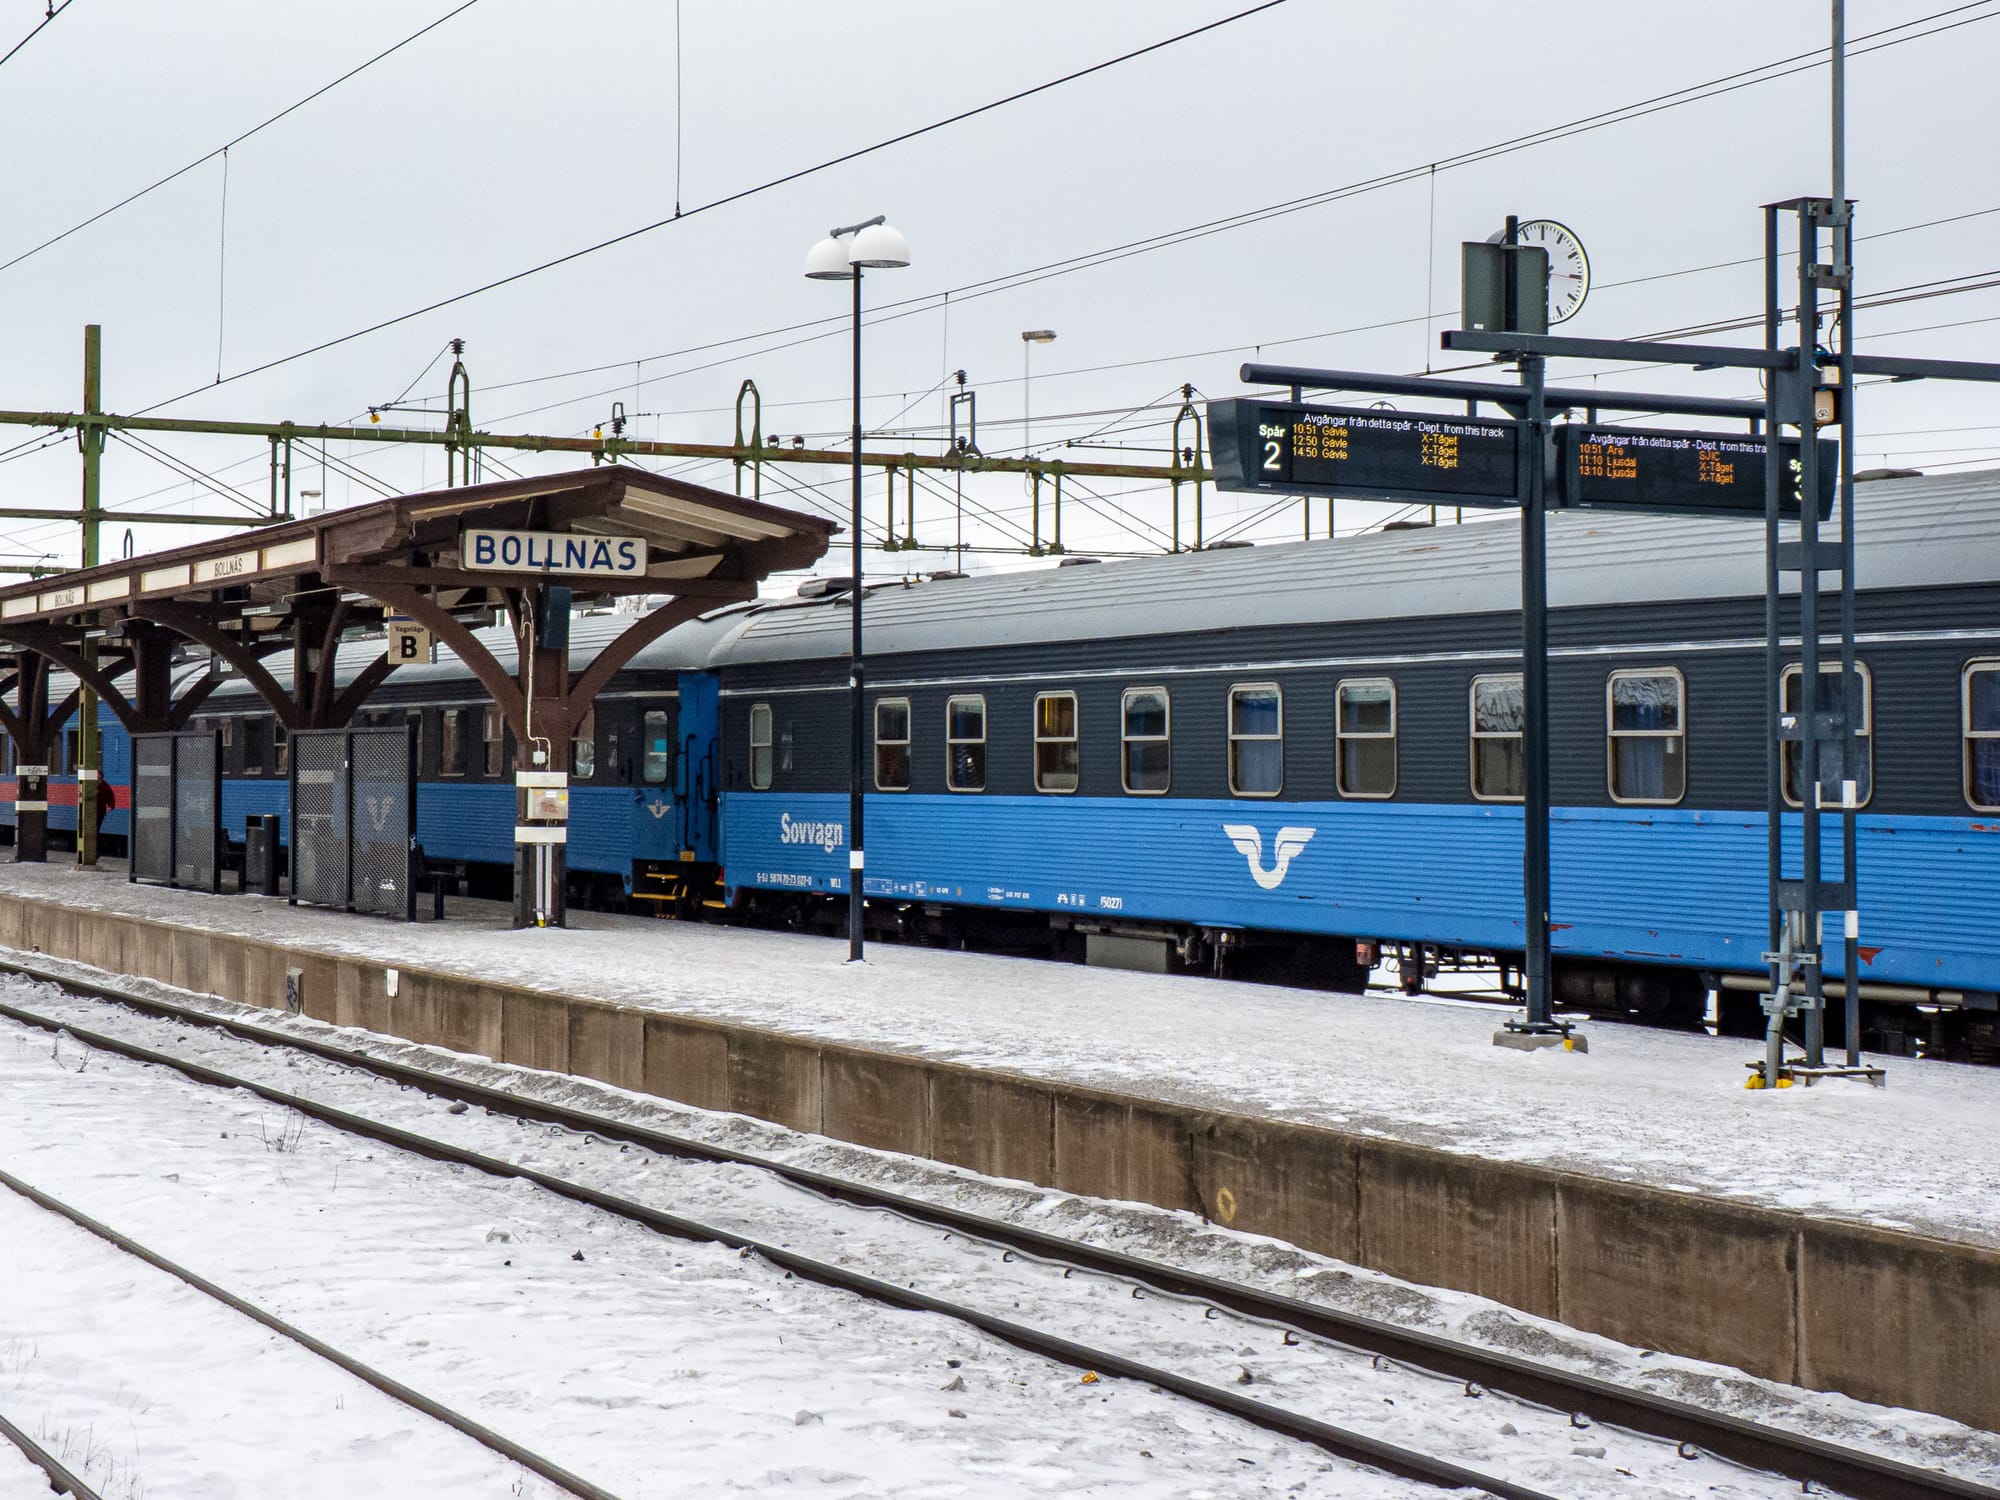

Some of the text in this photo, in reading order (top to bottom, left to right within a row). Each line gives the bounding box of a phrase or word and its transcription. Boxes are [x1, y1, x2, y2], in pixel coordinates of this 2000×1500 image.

[1259, 424, 1286, 439] Spår
[1304, 413, 1347, 427] Avgångar
[1349, 416, 1367, 428] från
[1368, 418, 1391, 429] detta
[1392, 420, 1412, 432] spår
[1444, 424, 1464, 434] from
[1465, 425, 1480, 436] this
[1481, 426, 1504, 438] track
[1421, 433, 1458, 446] X-Tåget
[1589, 433, 1630, 447] Avgångar
[1631, 436, 1649, 446] från
[1650, 437, 1671, 448] detta
[1672, 439, 1690, 450] spår
[1720, 441, 1739, 451] from
[1740, 443, 1754, 453] this
[1755, 444, 1767, 453] tra
[1263, 441, 1281, 469] 2
[1421, 444, 1458, 457] X-Tåget
[1421, 455, 1458, 469] X-Tåget
[1606, 456, 1637, 468] Ljusdal
[1699, 461, 1734, 474] X-Tåget
[1606, 467, 1637, 479] Ljusdal
[1699, 472, 1734, 485] X-Tåget
[476, 535, 636, 571] BOLLNÄS
[215, 556, 242, 577] BOLLNÄS
[401, 635, 418, 659] B
[781, 812, 843, 853] Sovvagn
